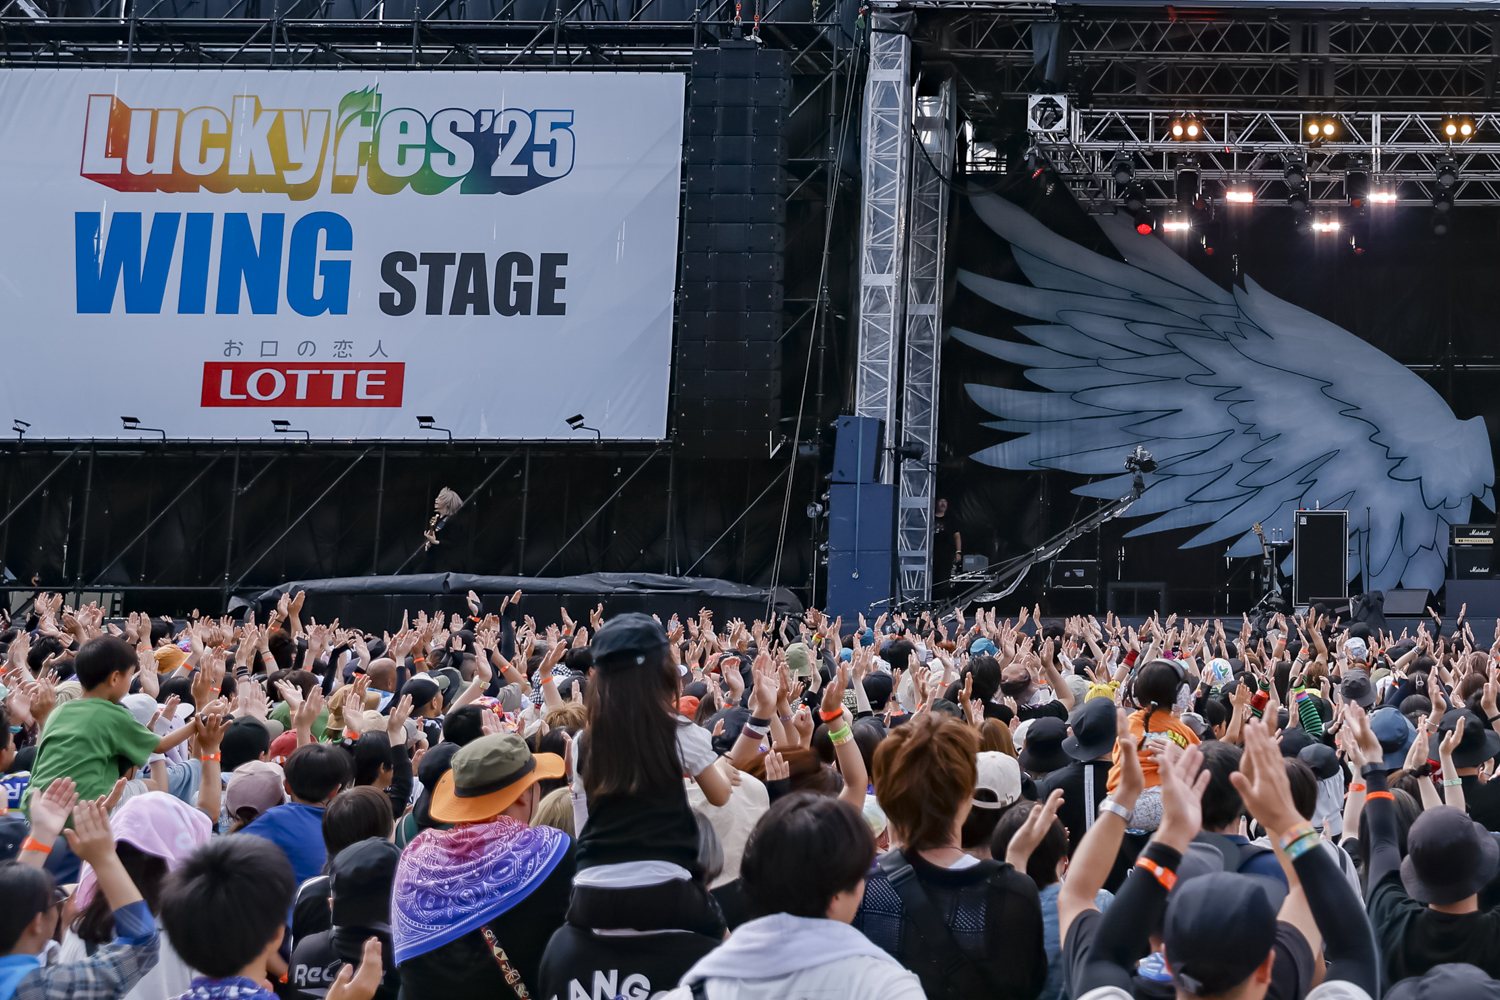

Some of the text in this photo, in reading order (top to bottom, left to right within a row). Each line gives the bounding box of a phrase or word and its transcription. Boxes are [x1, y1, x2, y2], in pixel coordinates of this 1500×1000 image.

[75, 211, 569, 318] WING STAGE
[223, 339, 390, 359] お口の恋人
[219, 368, 387, 401] LOTTE
[550, 969, 668, 1000] ANG
